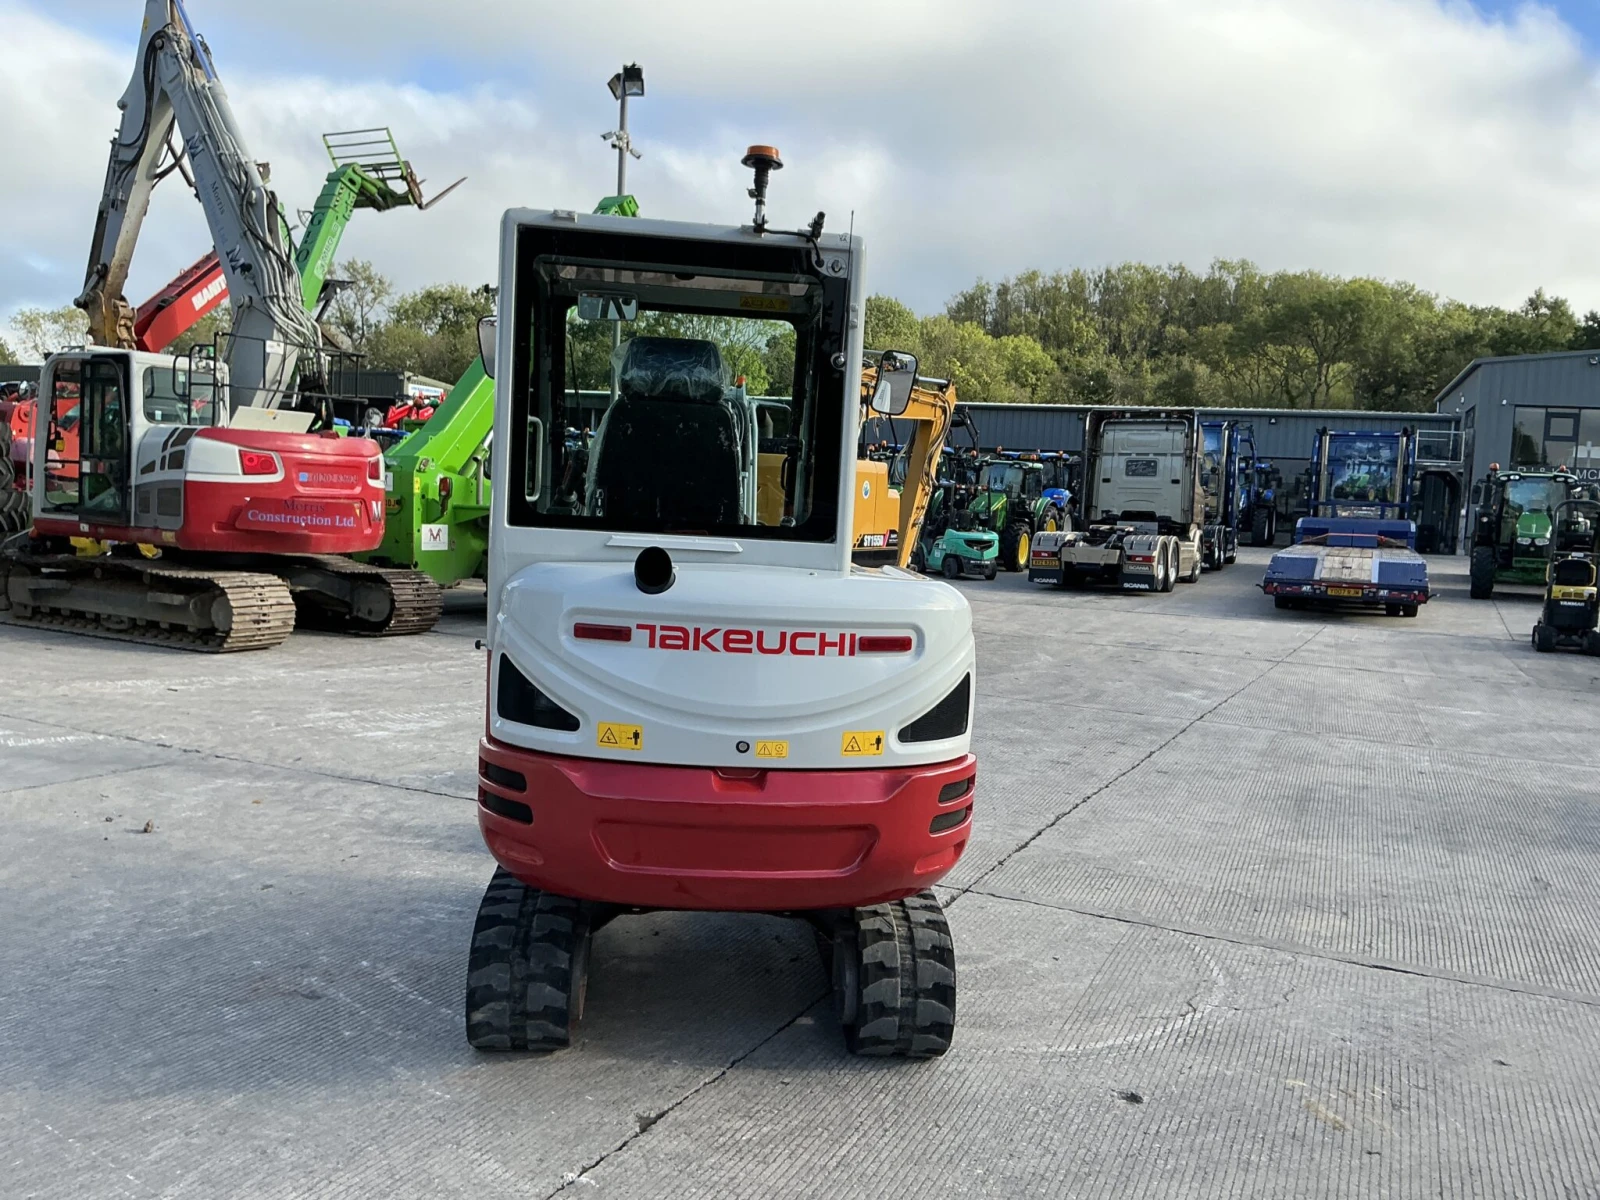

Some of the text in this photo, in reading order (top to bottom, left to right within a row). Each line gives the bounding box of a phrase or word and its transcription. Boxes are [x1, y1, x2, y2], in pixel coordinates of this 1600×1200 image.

[283, 499, 325, 512] Morris
[248, 509, 356, 527] Construction Ltd.
